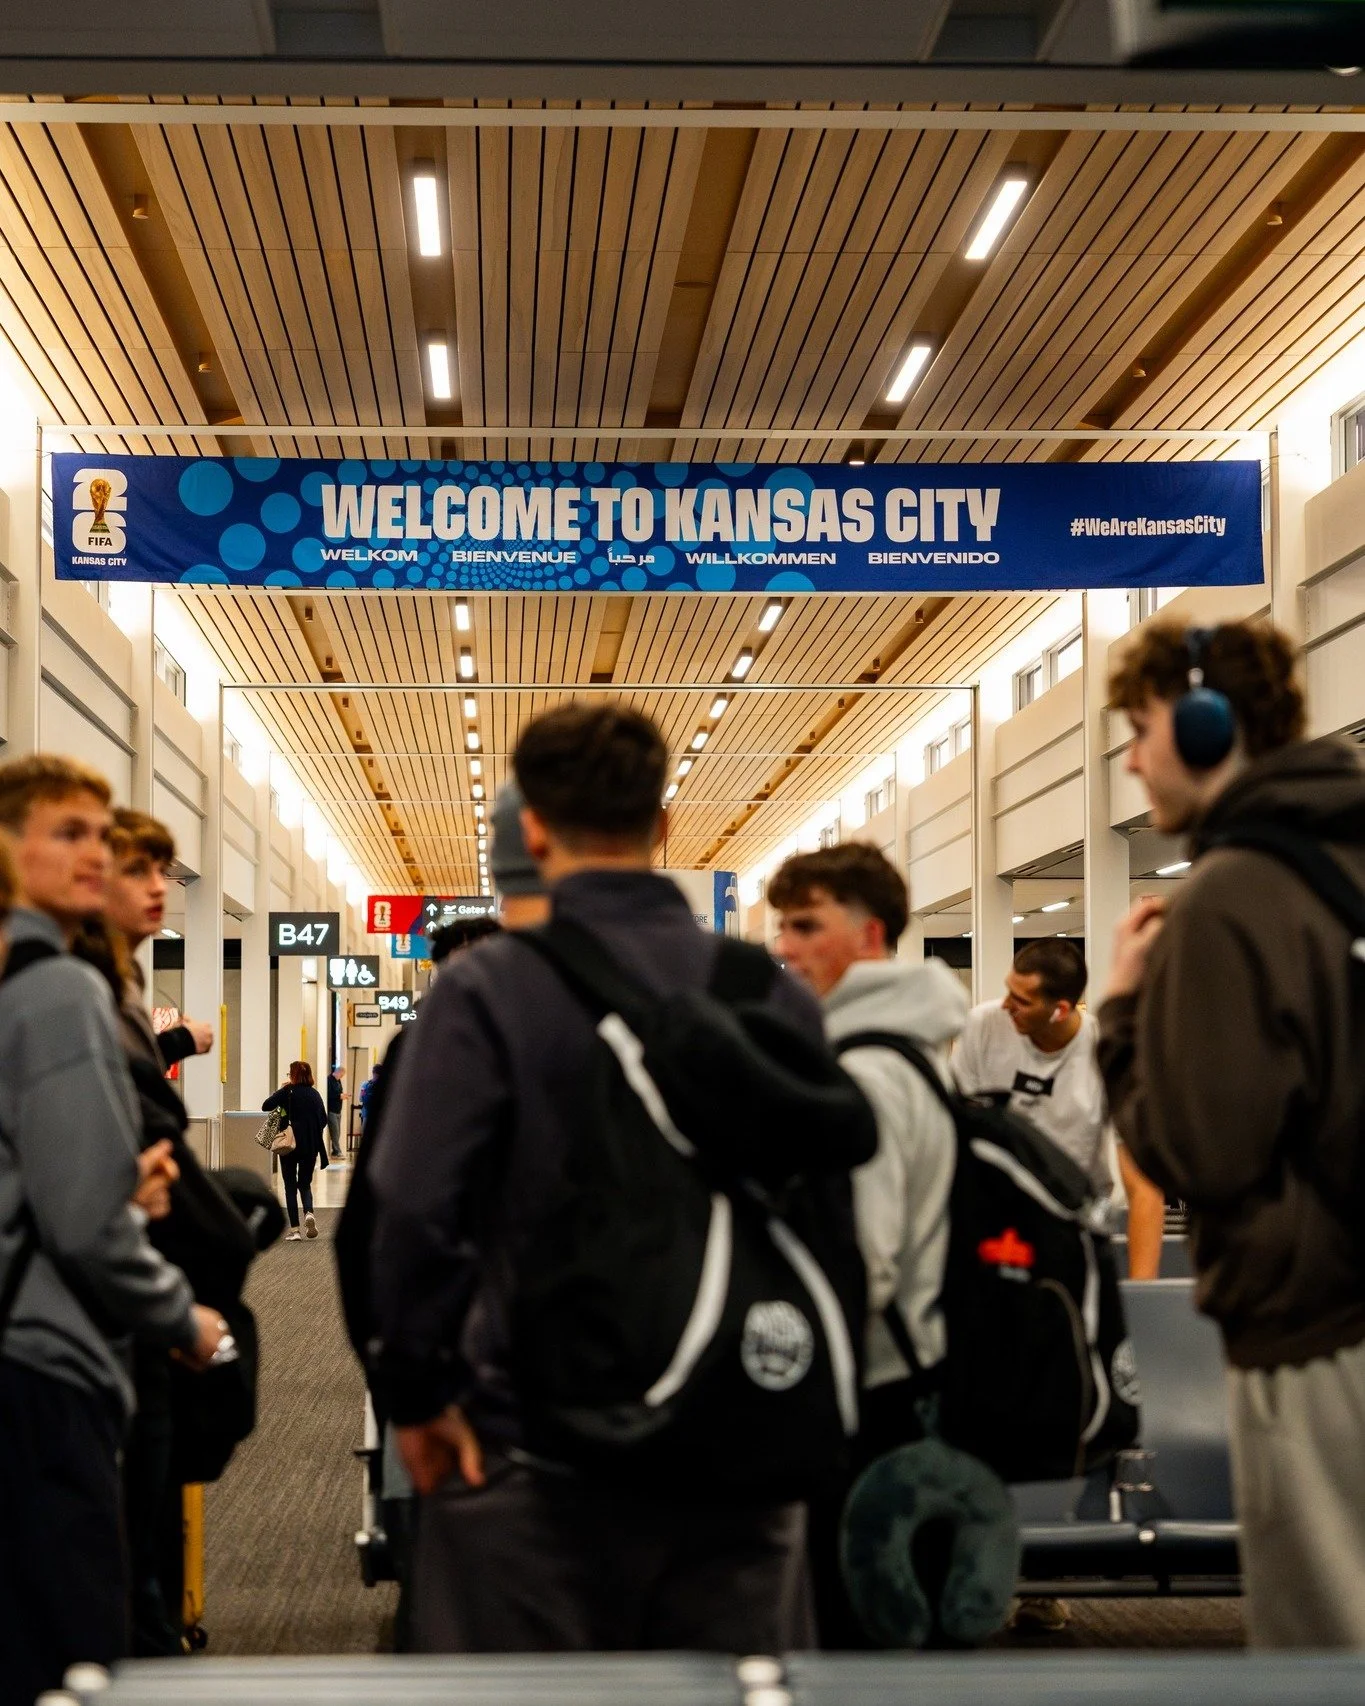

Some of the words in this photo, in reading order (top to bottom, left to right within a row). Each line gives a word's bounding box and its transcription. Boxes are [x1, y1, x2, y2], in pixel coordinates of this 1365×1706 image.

[321, 484, 581, 541] WELCOME
[590, 487, 654, 542] TO
[664, 487, 876, 543] KANSAS
[885, 487, 1001, 543] CITY
[1070, 515, 1227, 536] #WeAreKansasCity
[88, 537, 112, 546] FIFA
[72, 556, 105, 565] KANSAS
[108, 557, 127, 566] CITY
[320, 549, 418, 562] WELKOM
[452, 550, 577, 564] BIENVENUE
[685, 552, 837, 566] WILLKOMMEN
[868, 551, 1001, 565] BIENVENIDO
[457, 903, 486, 915] Gates
[278, 923, 330, 946] B47
[378, 995, 409, 1010] B49
